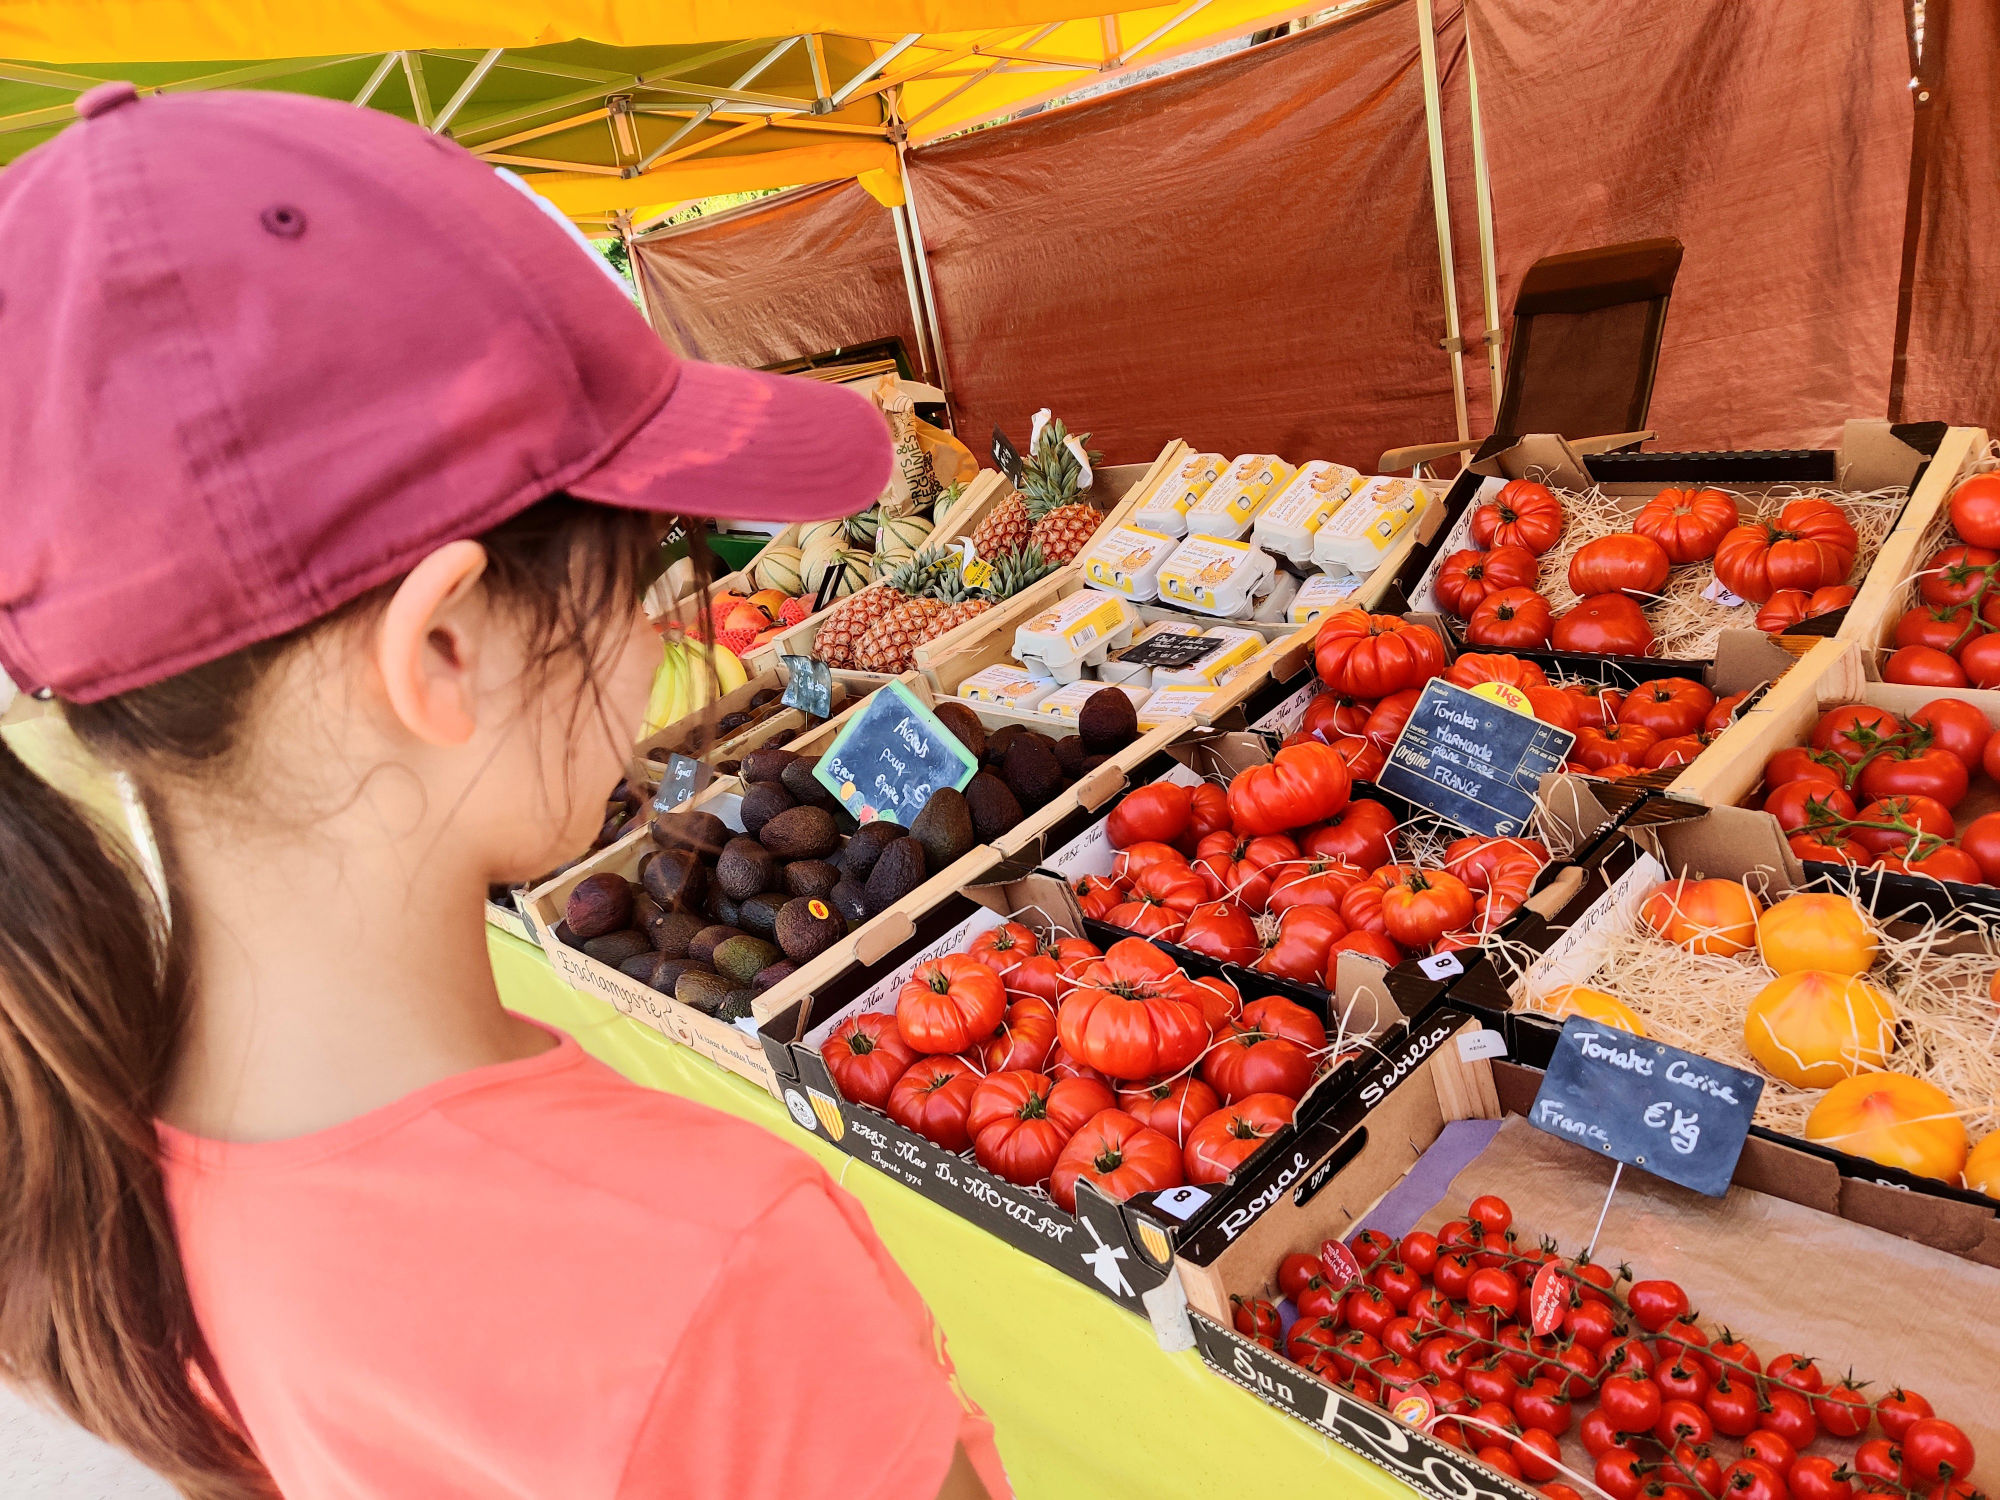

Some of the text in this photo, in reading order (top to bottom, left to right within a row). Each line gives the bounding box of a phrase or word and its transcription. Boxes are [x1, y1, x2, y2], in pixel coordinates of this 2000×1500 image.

[901, 459, 920, 507] FRUITS
[1495, 684, 1523, 709] 1kg
[1395, 744, 1432, 771] Origine
[1435, 958, 1452, 968] 8
[1573, 1032, 1654, 1077] Tomates
[1217, 1027, 1449, 1241] Royal Sevilla
[1540, 1099, 1608, 1142] France
[871, 1150, 922, 1187] Depuis 1976
[1310, 1160, 1331, 1190] 1976
[894, 1141, 927, 1169] Mas
[935, 1163, 958, 1187] Du
[962, 1176, 1073, 1243] MOULIN
[1173, 1190, 1191, 1202] 8
[1234, 1346, 1508, 1500] Sun Ro
